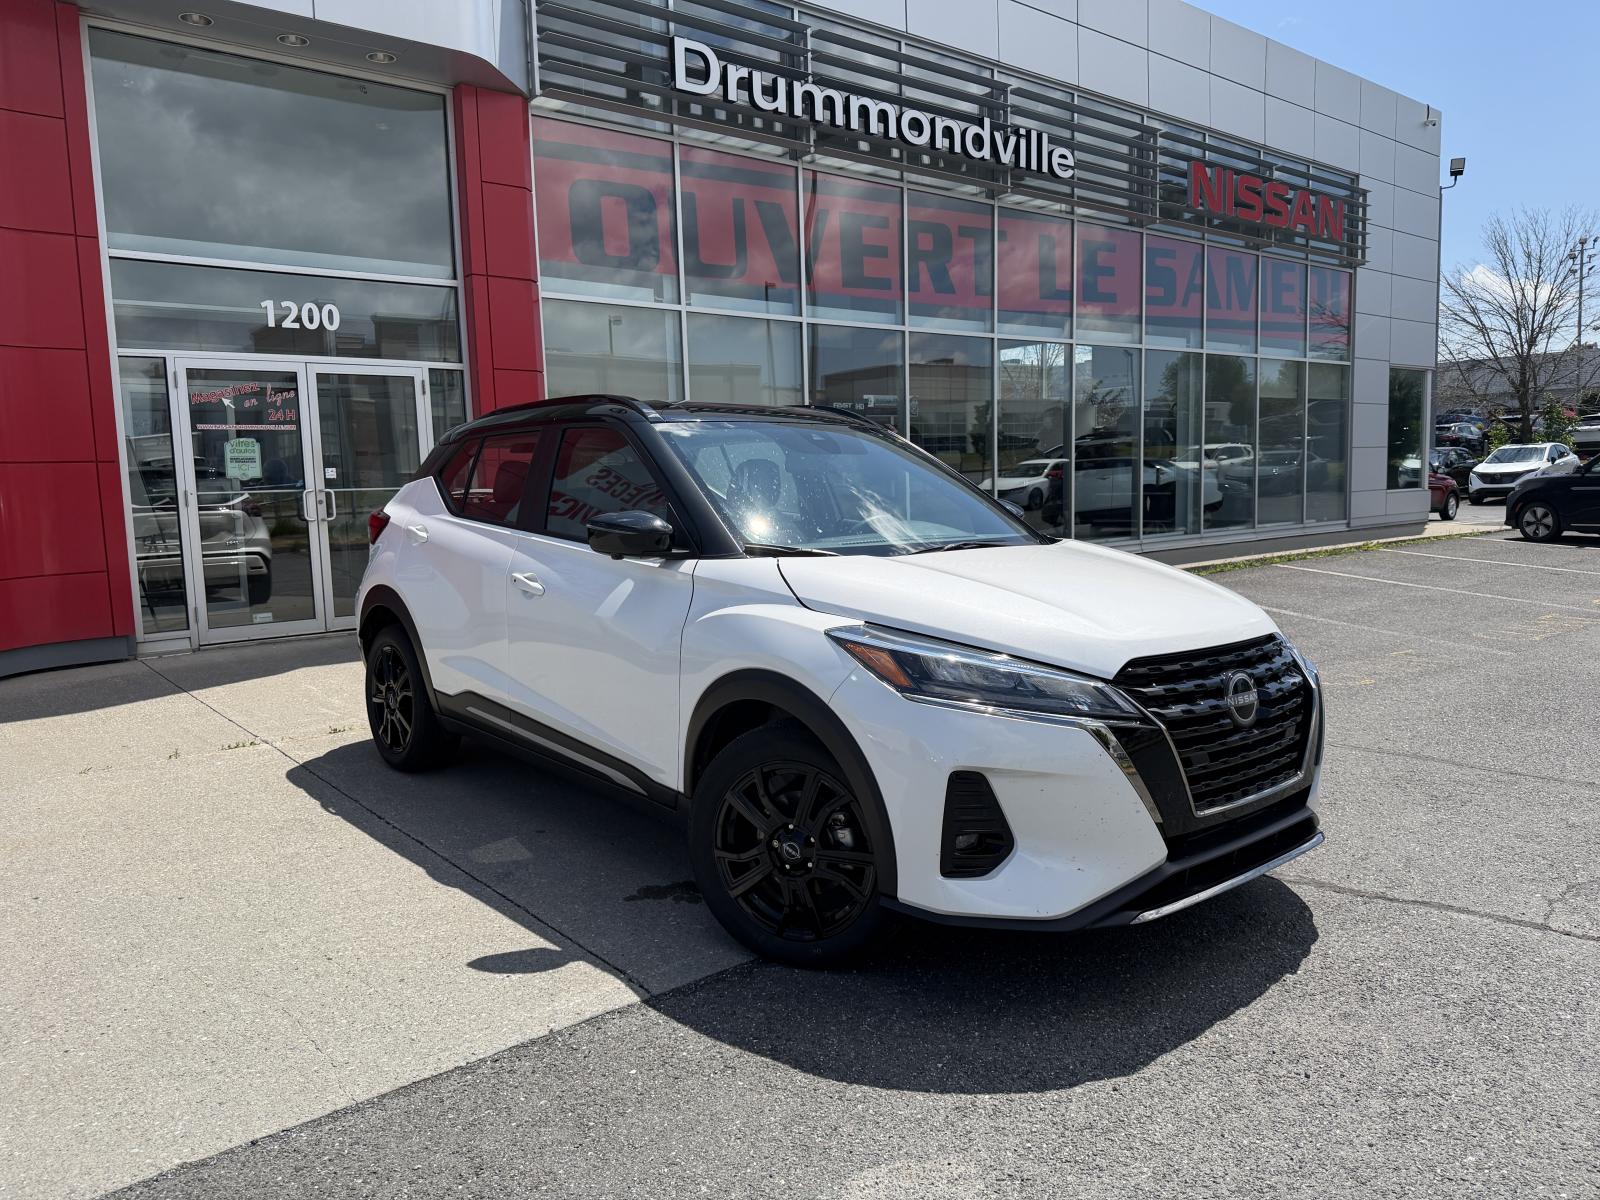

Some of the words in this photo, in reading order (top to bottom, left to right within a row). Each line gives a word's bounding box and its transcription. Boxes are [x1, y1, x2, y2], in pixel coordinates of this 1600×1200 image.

[672, 36, 1076, 178] Drummondville
[1190, 161, 1345, 241] NISSAN
[568, 178, 1007, 298] OUVERT
[1037, 233, 1118, 304] LE
[1144, 246, 1342, 318] SAMEDI
[260, 299, 340, 331] 1200
[265, 382, 296, 406] ligne
[267, 408, 284, 421] 24
[285, 409, 296, 421] H
[1227, 691, 1258, 706] NISSAN
